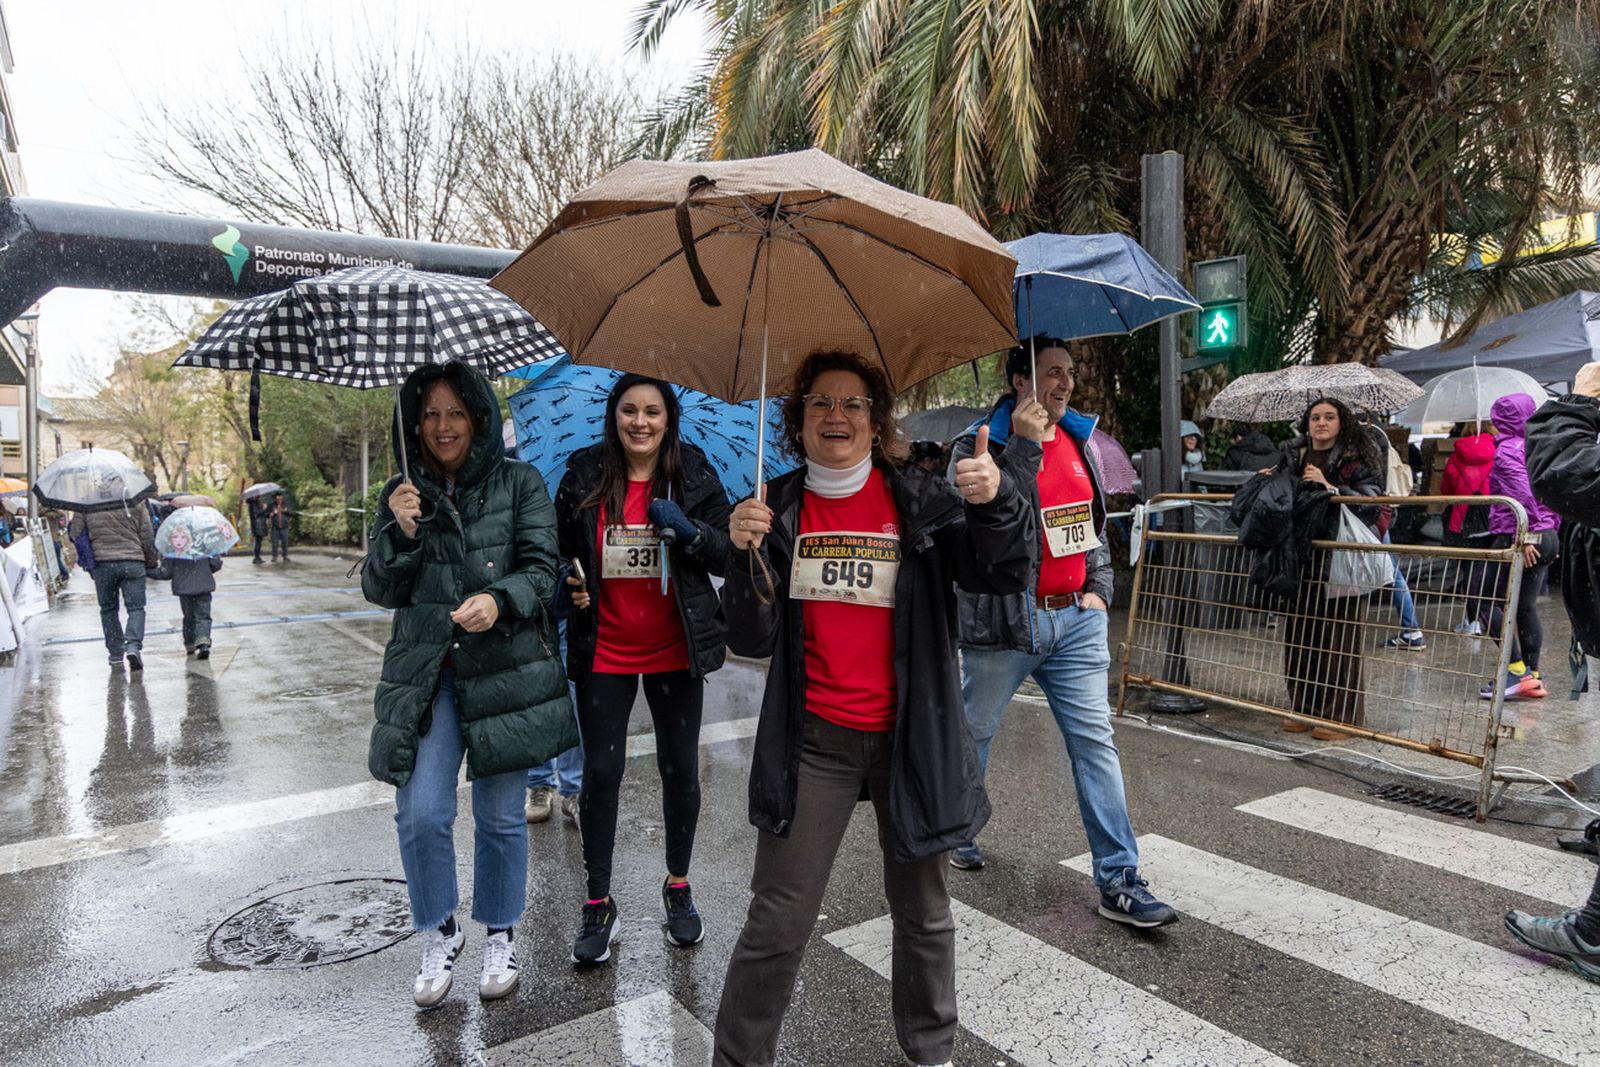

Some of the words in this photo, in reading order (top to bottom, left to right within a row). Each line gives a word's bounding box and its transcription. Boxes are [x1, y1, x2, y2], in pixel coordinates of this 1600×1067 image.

[254, 245, 325, 264] Patronato
[328, 253, 394, 268] Municipal
[255, 260, 321, 278] Deportes
[805, 537, 820, 546] IES
[822, 537, 839, 546] San
[841, 537, 864, 547] Juan
[866, 538, 894, 549] Bosco
[1062, 524, 1085, 545] 703
[627, 547, 659, 568] 331
[802, 547, 809, 557] V
[811, 547, 852, 558] CARRERA
[855, 548, 896, 560] POPULAR
[821, 560, 874, 589] 649
